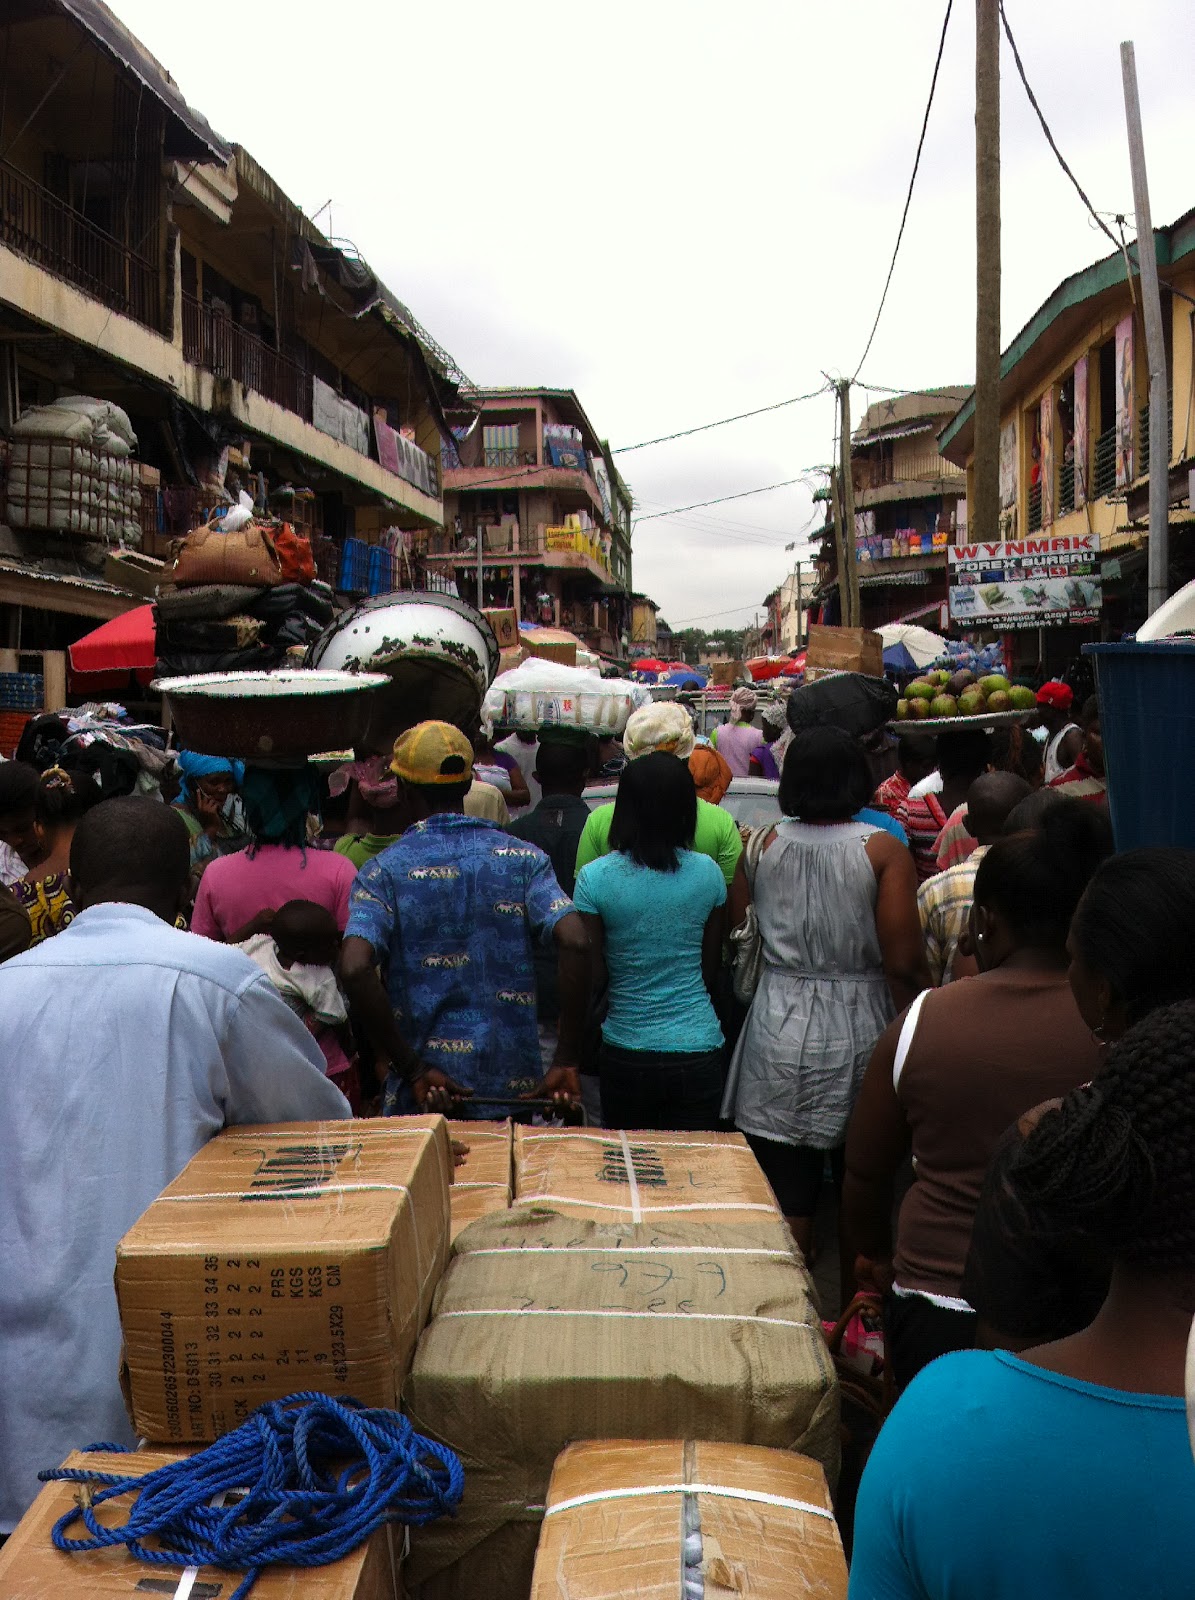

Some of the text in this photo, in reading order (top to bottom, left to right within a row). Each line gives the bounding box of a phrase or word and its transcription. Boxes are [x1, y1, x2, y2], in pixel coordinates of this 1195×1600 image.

[953, 535, 1093, 560] WYNMAK
[955, 552, 1095, 572] FOREX BUREAU
[204, 1256, 219, 1272] 35
[226, 1259, 241, 1268] 2
[270, 1268, 286, 1298] PRS
[289, 1267, 304, 1298] KGS
[308, 1265, 323, 1298] KGS
[326, 1265, 341, 1287] CM
[204, 1277, 218, 1295] 34
[226, 1283, 241, 1292] 2
[204, 1301, 219, 1318] 33
[227, 1307, 241, 1316] 2
[246, 1259, 266, 1381] 2 2 2 2 2 2
[206, 1325, 220, 1341] 32
[227, 1330, 242, 1339] 2
[207, 1351, 221, 1366] 31
[229, 1353, 243, 1361] 2
[208, 1372, 222, 1388] 30
[230, 1375, 245, 1384] 2
